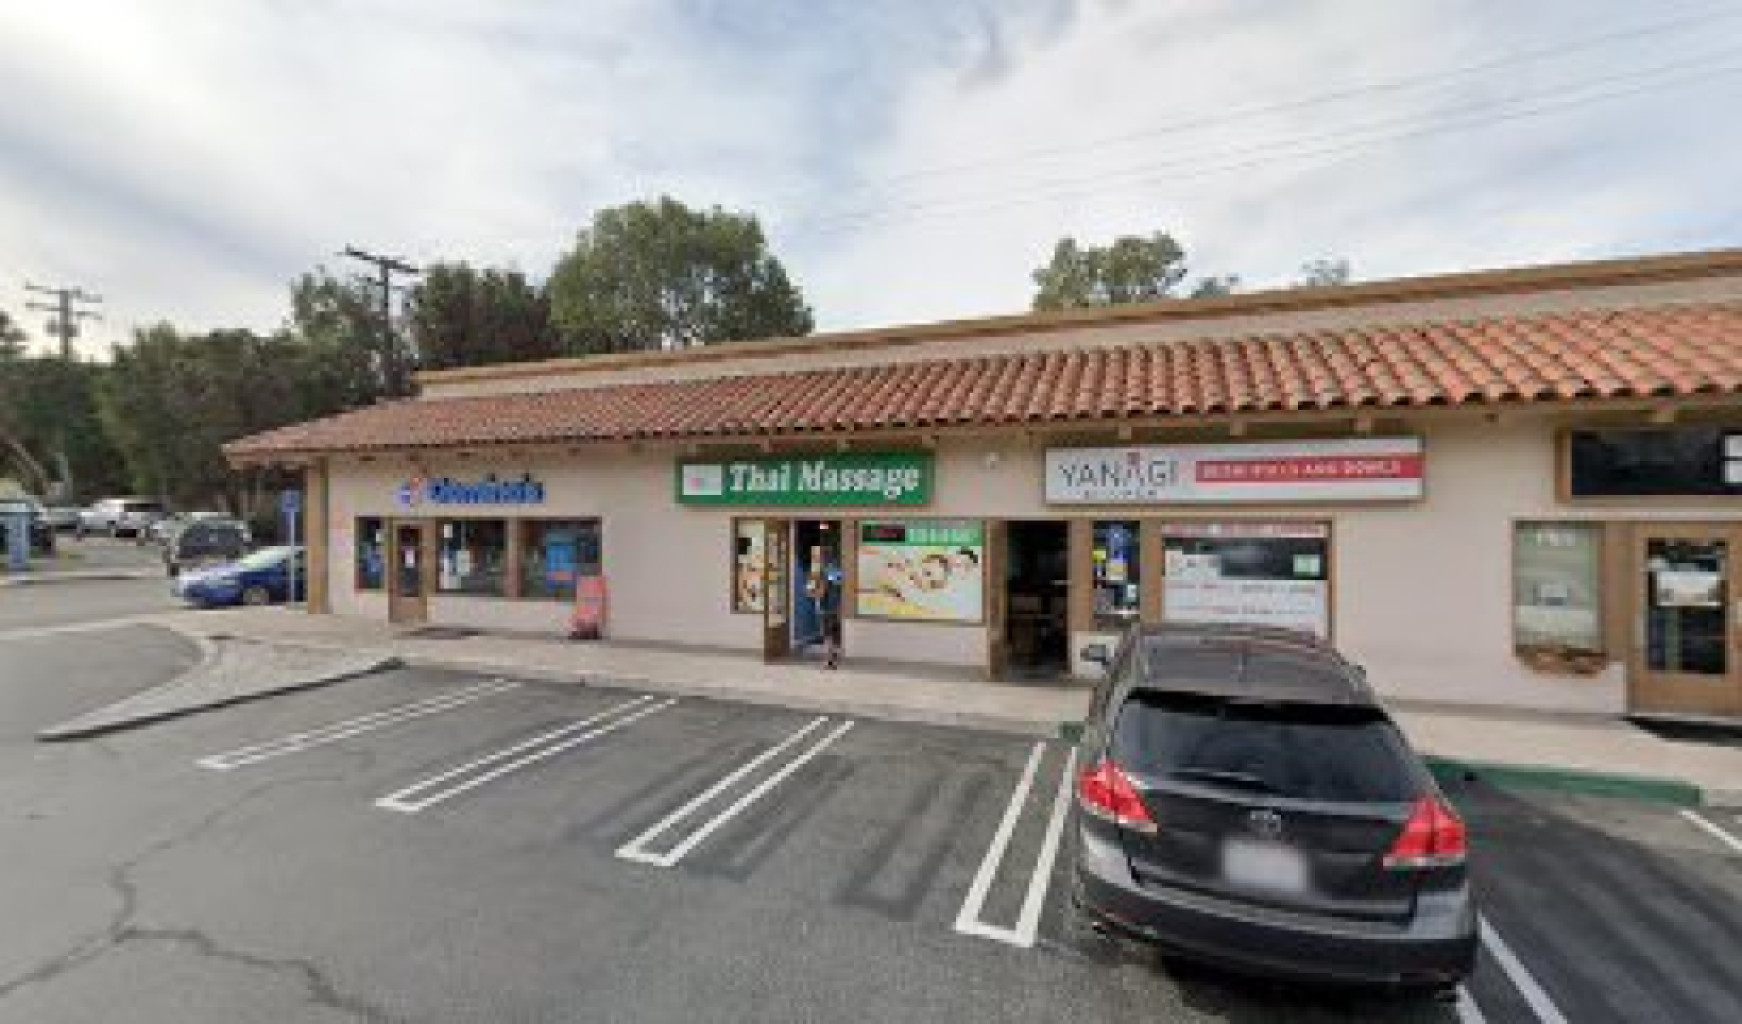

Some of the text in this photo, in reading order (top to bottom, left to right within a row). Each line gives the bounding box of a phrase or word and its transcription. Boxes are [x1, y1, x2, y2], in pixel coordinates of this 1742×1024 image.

[729, 460, 920, 499] Thai Massage
[1058, 458, 1178, 487] YANAGI
